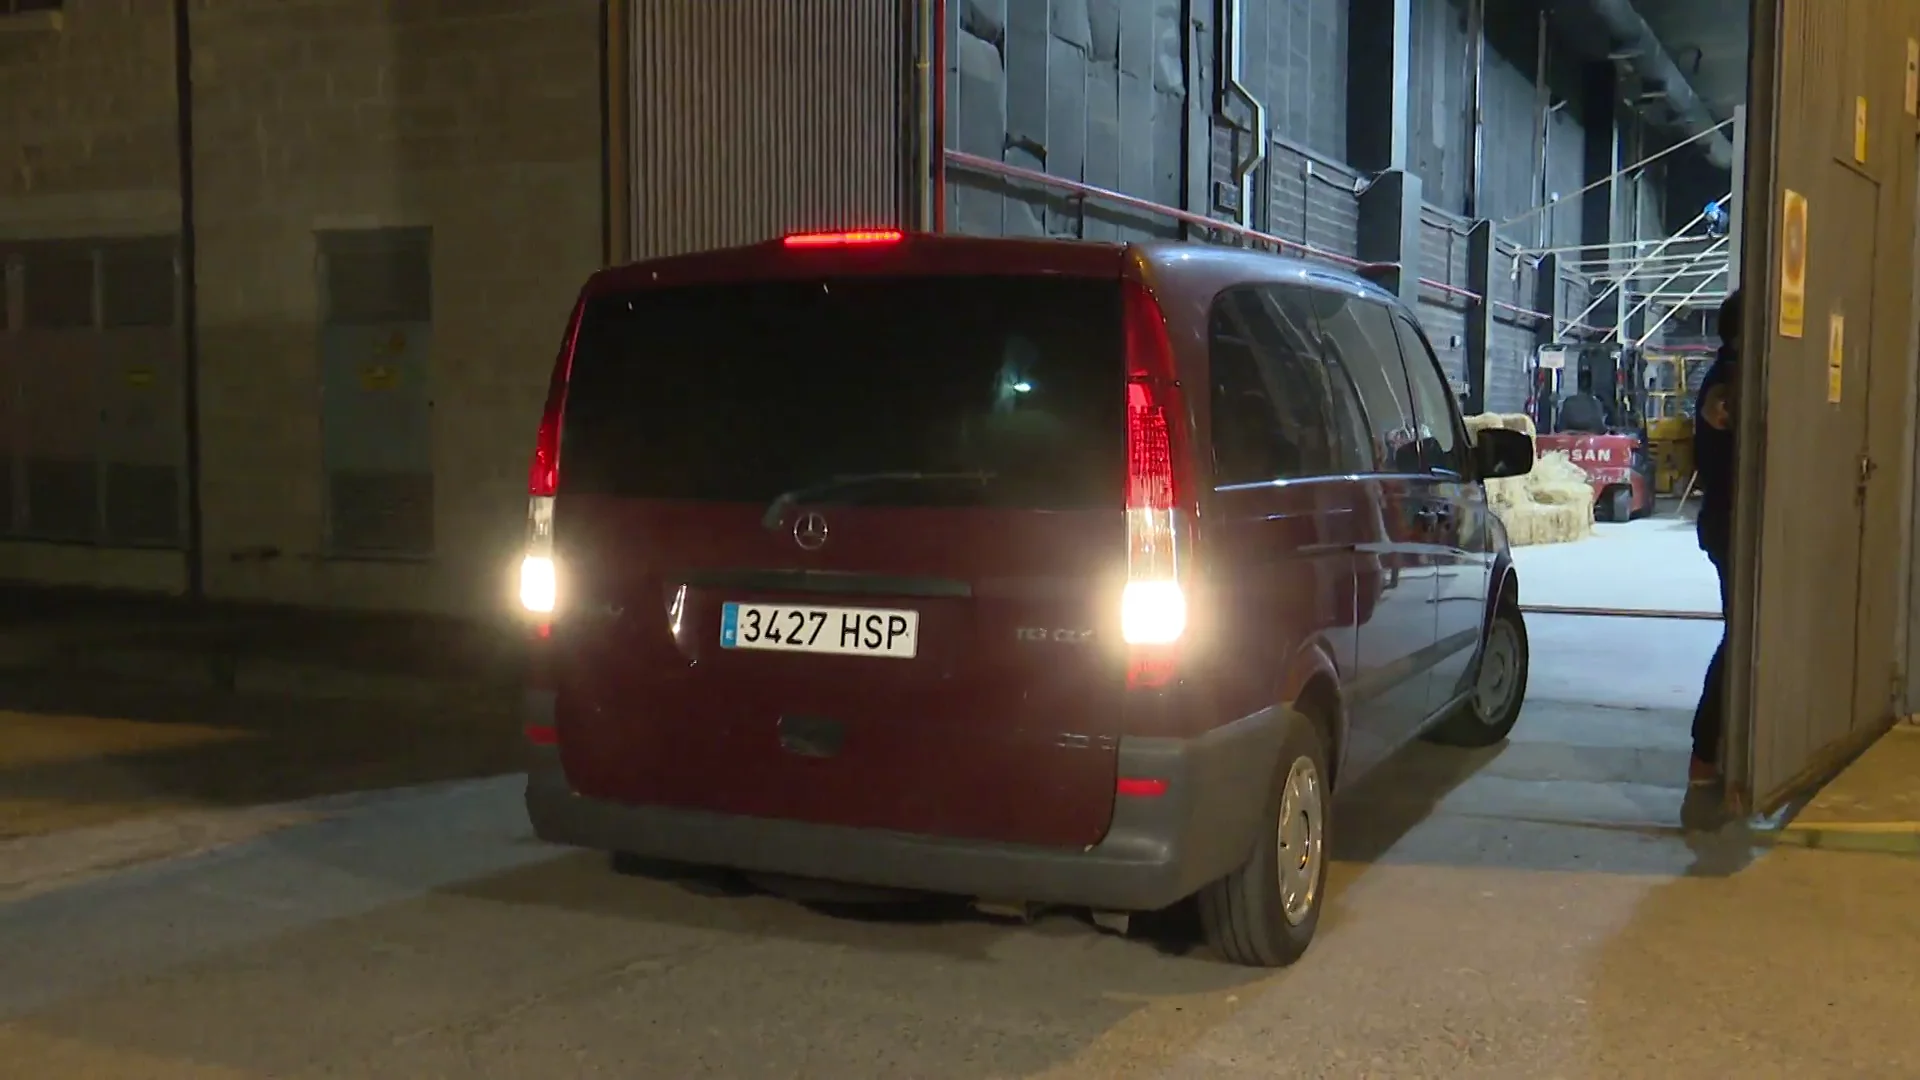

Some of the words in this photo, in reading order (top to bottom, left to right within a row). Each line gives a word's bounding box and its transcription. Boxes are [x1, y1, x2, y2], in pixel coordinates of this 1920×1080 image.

[1541, 448, 1611, 462] SAN
[744, 609, 828, 645] 3427
[840, 613, 907, 649] HSP
